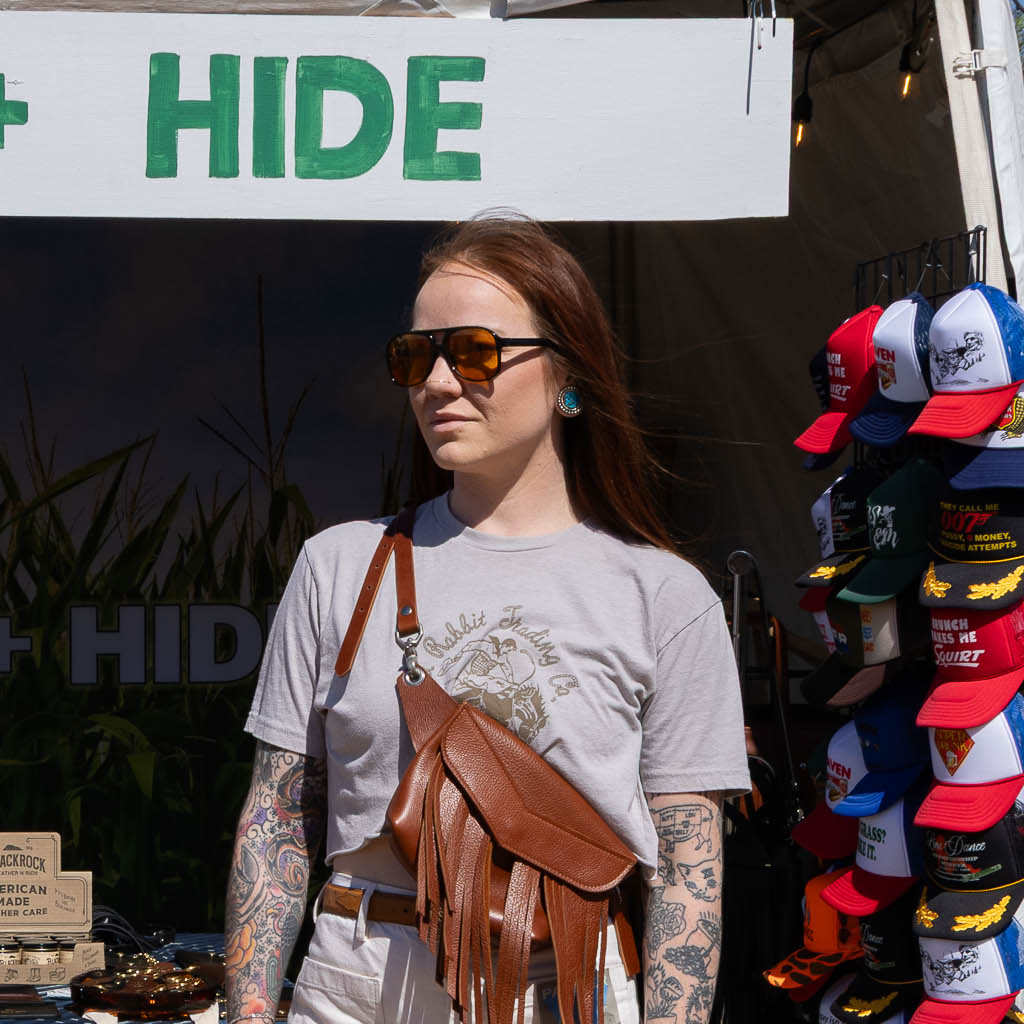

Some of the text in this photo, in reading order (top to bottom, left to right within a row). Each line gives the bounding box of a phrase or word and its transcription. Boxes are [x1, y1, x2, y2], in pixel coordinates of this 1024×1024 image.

[145, 52, 486, 181] HIDE
[959, 504, 983, 512] CALL
[968, 540, 1017, 552] ATTEMPTS
[974, 532, 1011, 543] MONEY,
[70, 604, 280, 684] HID
[423, 610, 487, 659] Rabbit
[498, 604, 561, 668] Trading
[959, 631, 978, 644] ME
[934, 644, 986, 668] SQUIRT
[945, 834, 987, 857] Dance
[22, 907, 48, 916] CARE
